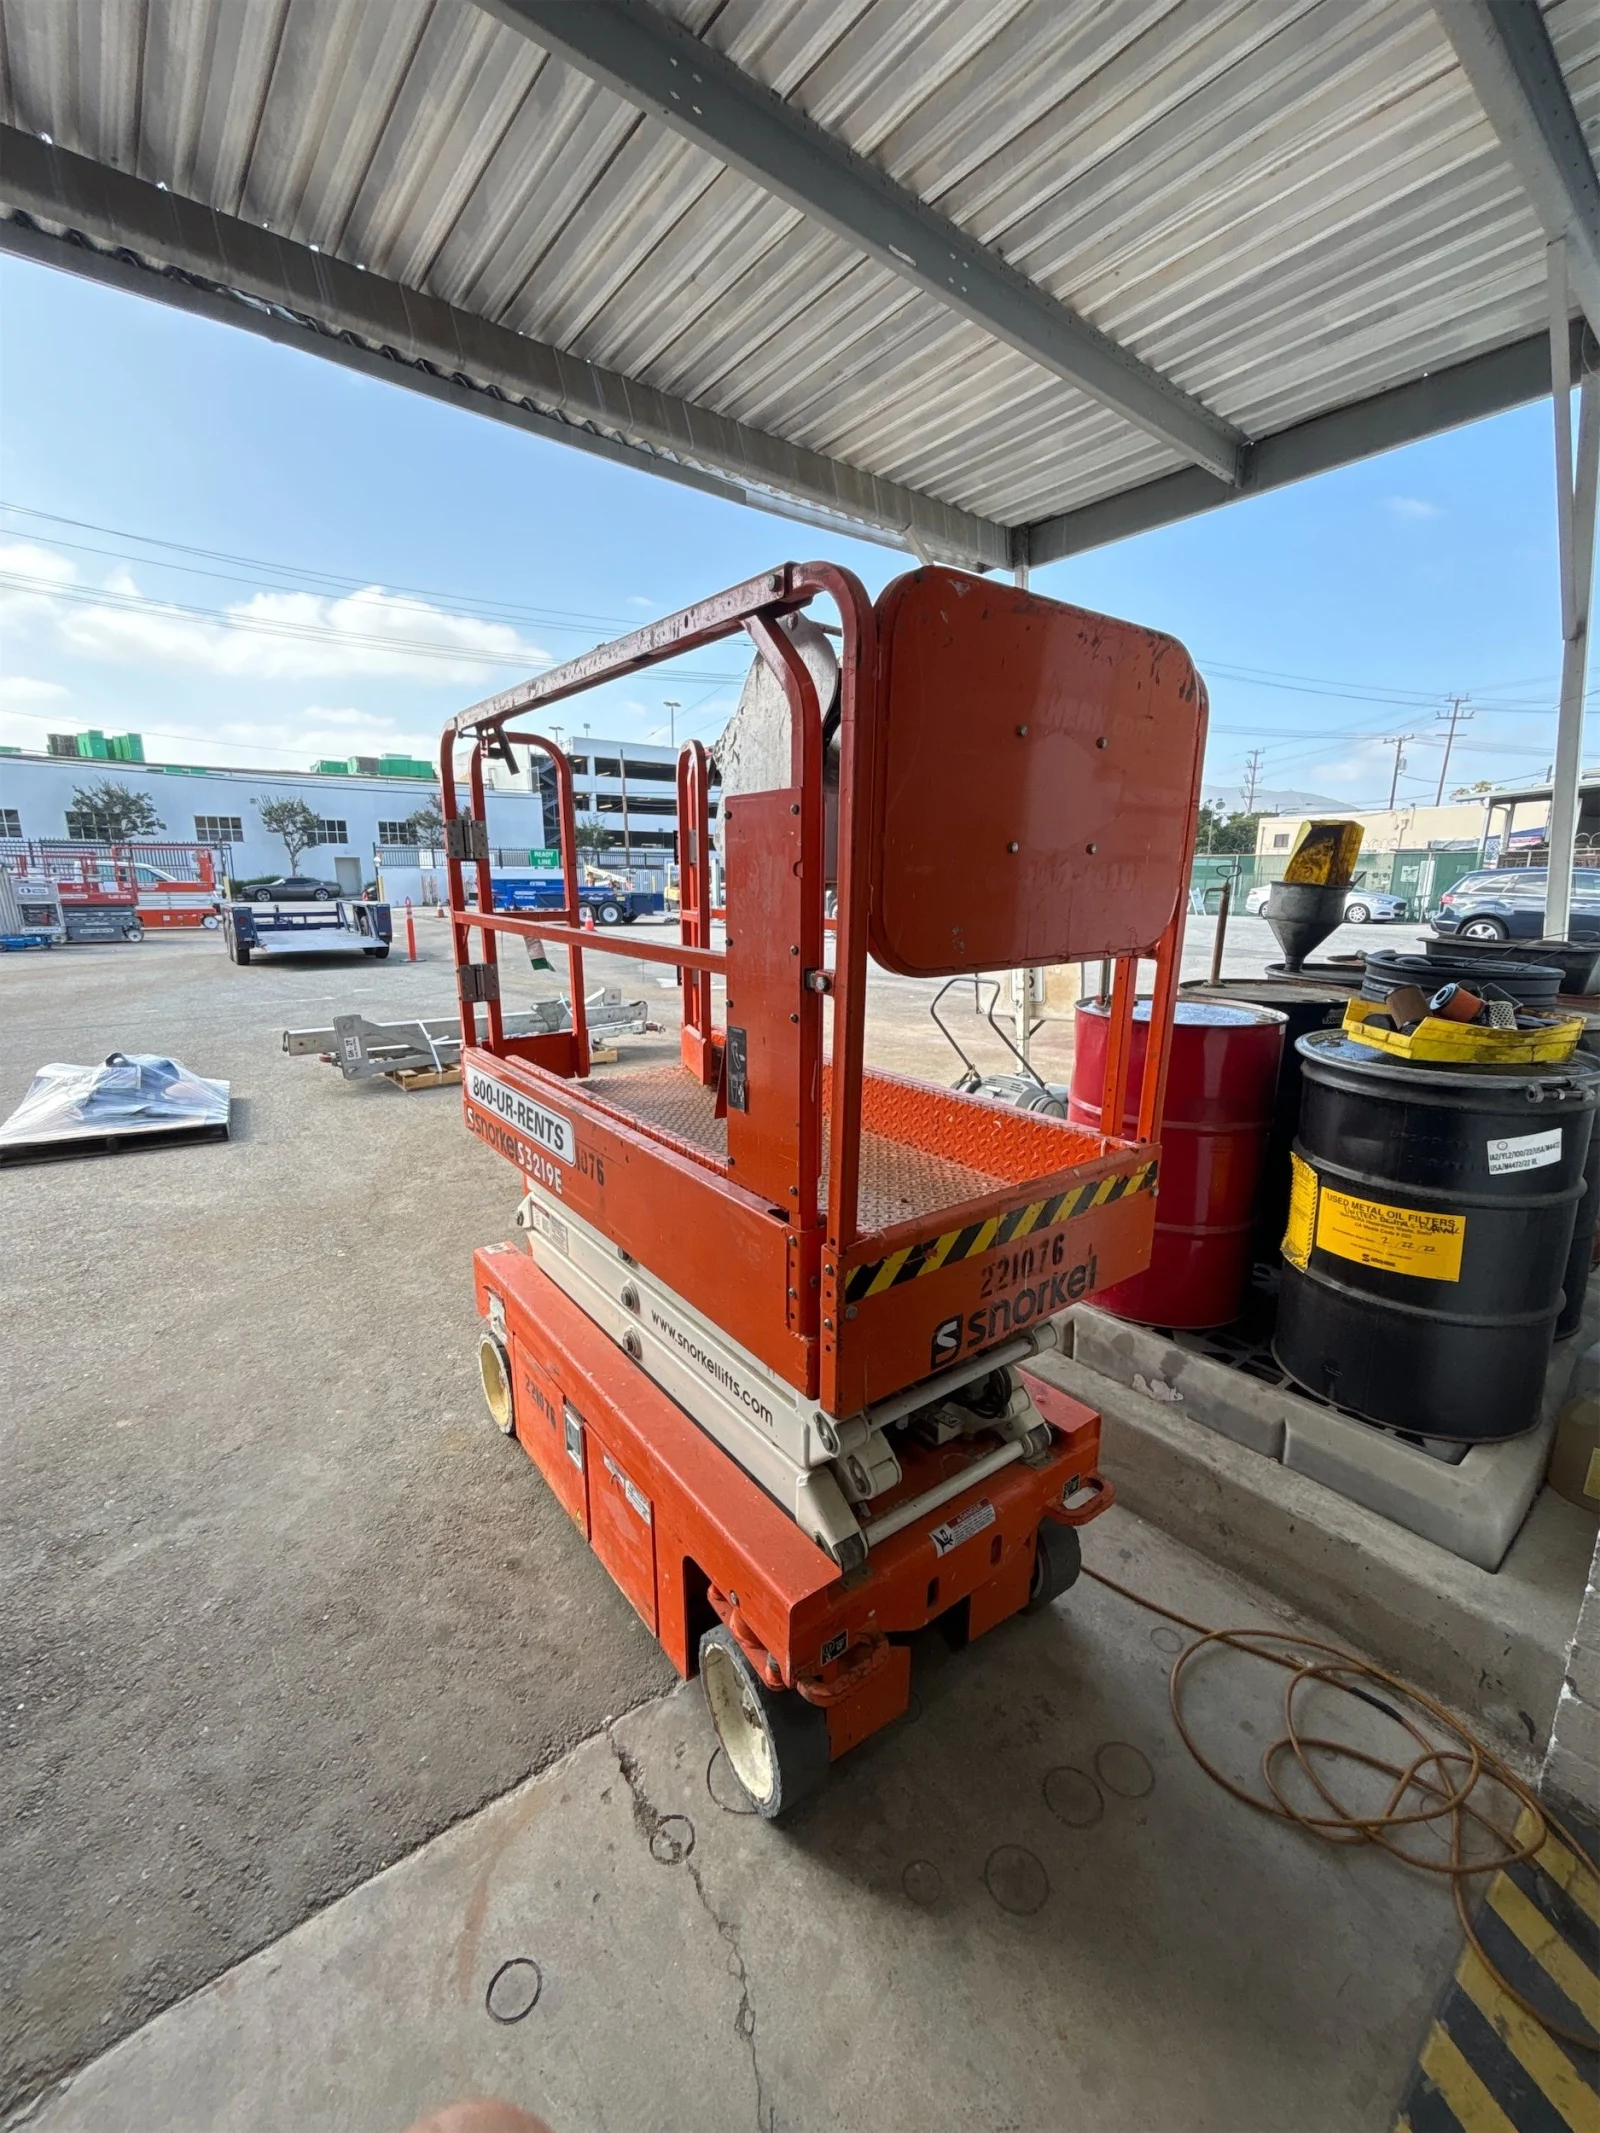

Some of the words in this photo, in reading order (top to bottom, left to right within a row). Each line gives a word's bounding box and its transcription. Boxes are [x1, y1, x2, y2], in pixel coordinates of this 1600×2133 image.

[472, 1075, 564, 1151] 800-UR-RENTS
[517, 1141, 563, 1195] S3219E
[1327, 1193, 1349, 1206] USED
[1351, 1201, 1382, 1216] METAL
[1387, 1210, 1404, 1220] OIL
[1408, 1214, 1456, 1228] FILTERS
[980, 1233, 1065, 1299] 221076
[967, 1254, 1097, 1349] snorkel
[651, 1308, 774, 1427] www.snorkellifts.com
[959, 1503, 983, 1521] DANGER
